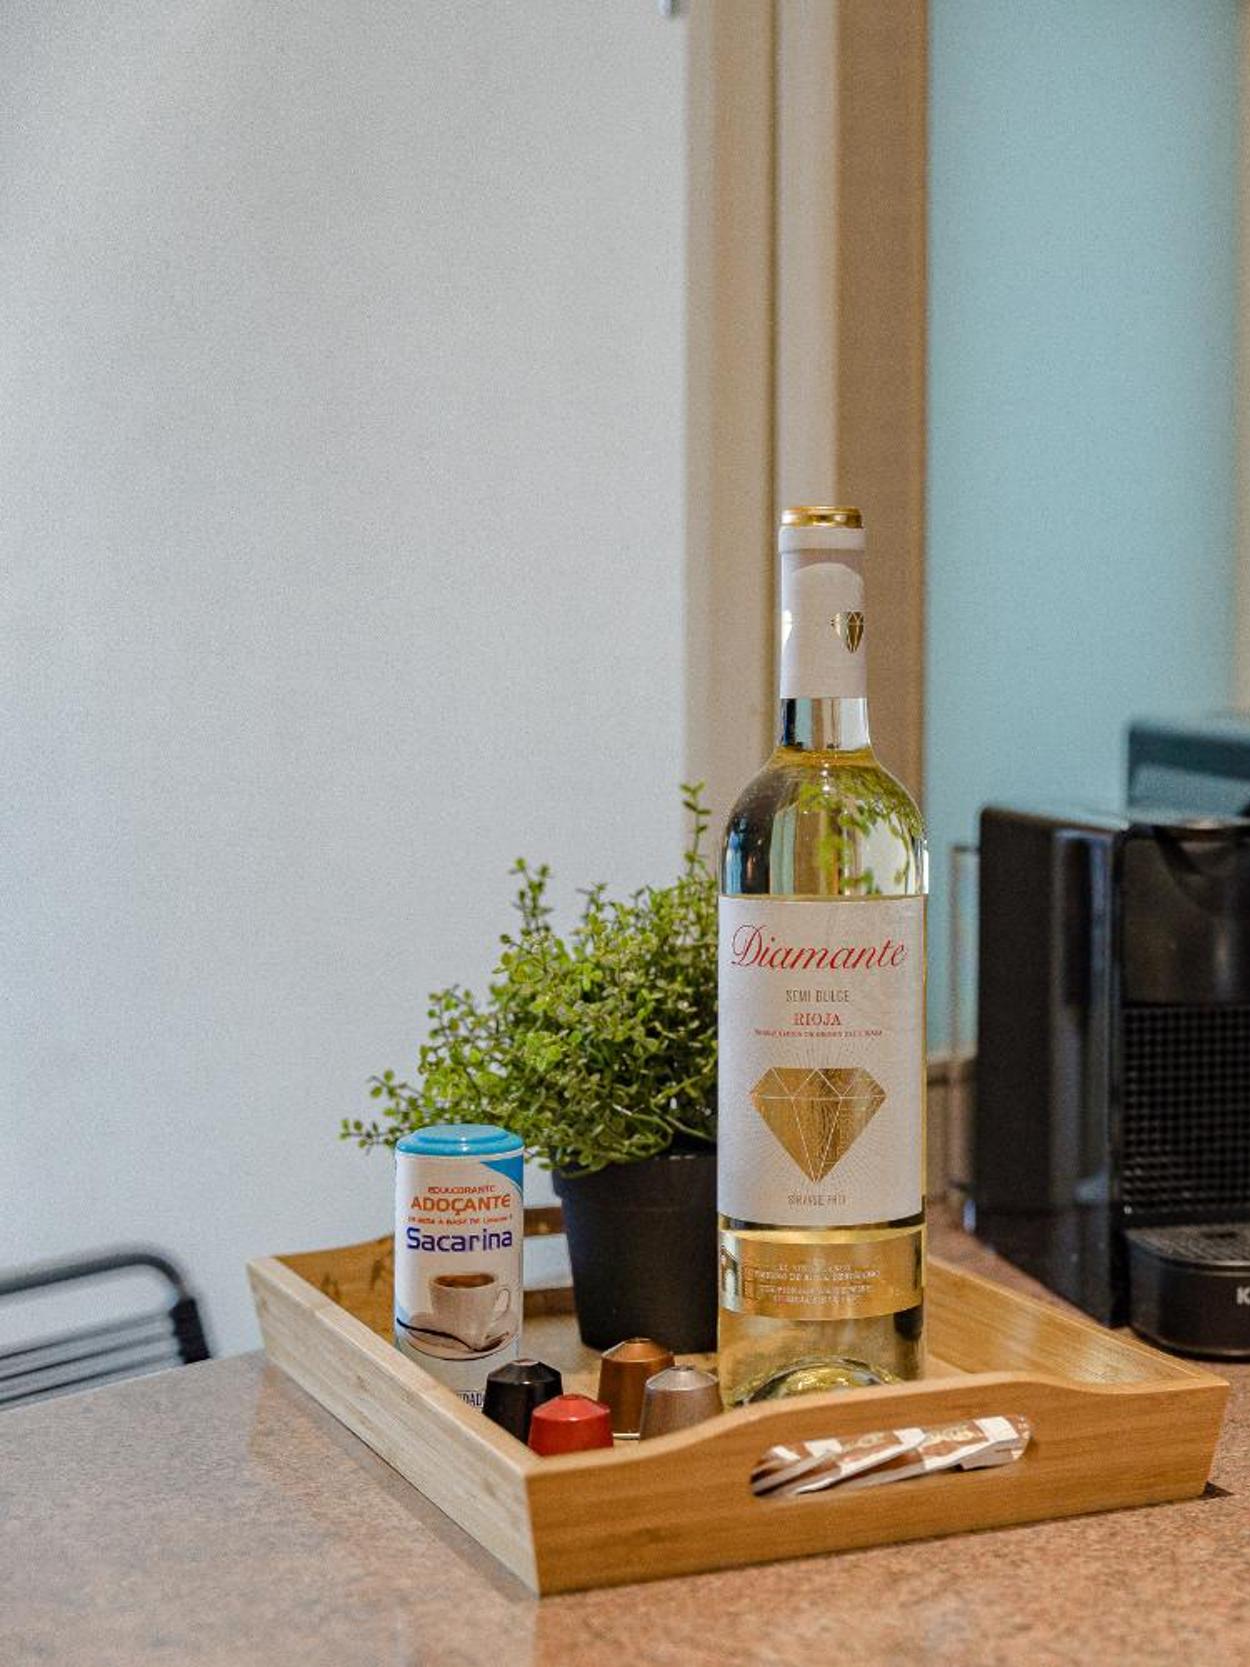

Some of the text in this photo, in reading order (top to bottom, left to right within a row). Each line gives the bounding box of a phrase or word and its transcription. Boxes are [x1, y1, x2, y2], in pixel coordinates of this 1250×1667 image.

[731, 923, 908, 969] Diamante
[786, 989, 850, 1004] SEMI DULCE
[793, 1012, 842, 1026] RIOJA
[410, 1194, 511, 1216] ADOÇANTE
[406, 1226, 513, 1252] Sacarina
